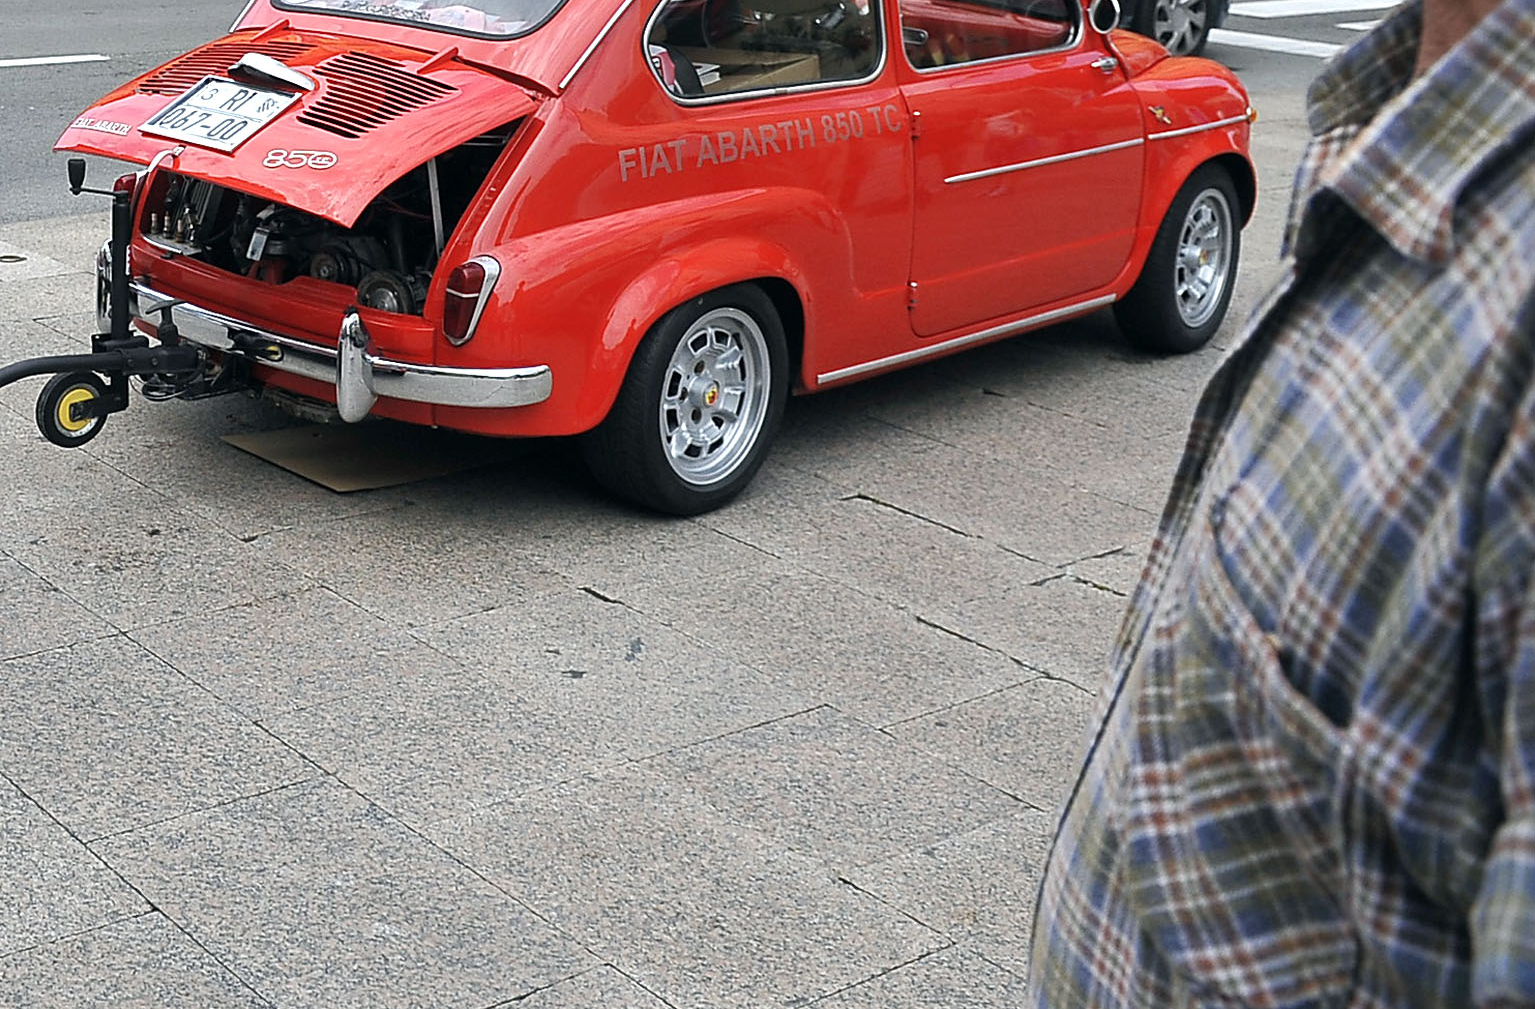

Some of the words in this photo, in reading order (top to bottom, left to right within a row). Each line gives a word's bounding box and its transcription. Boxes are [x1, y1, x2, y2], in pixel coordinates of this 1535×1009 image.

[219, 88, 258, 112] RI
[618, 139, 687, 183] FIAT
[697, 118, 816, 168] ABARTH
[821, 110, 863, 143] 850
[867, 104, 902, 134] TC
